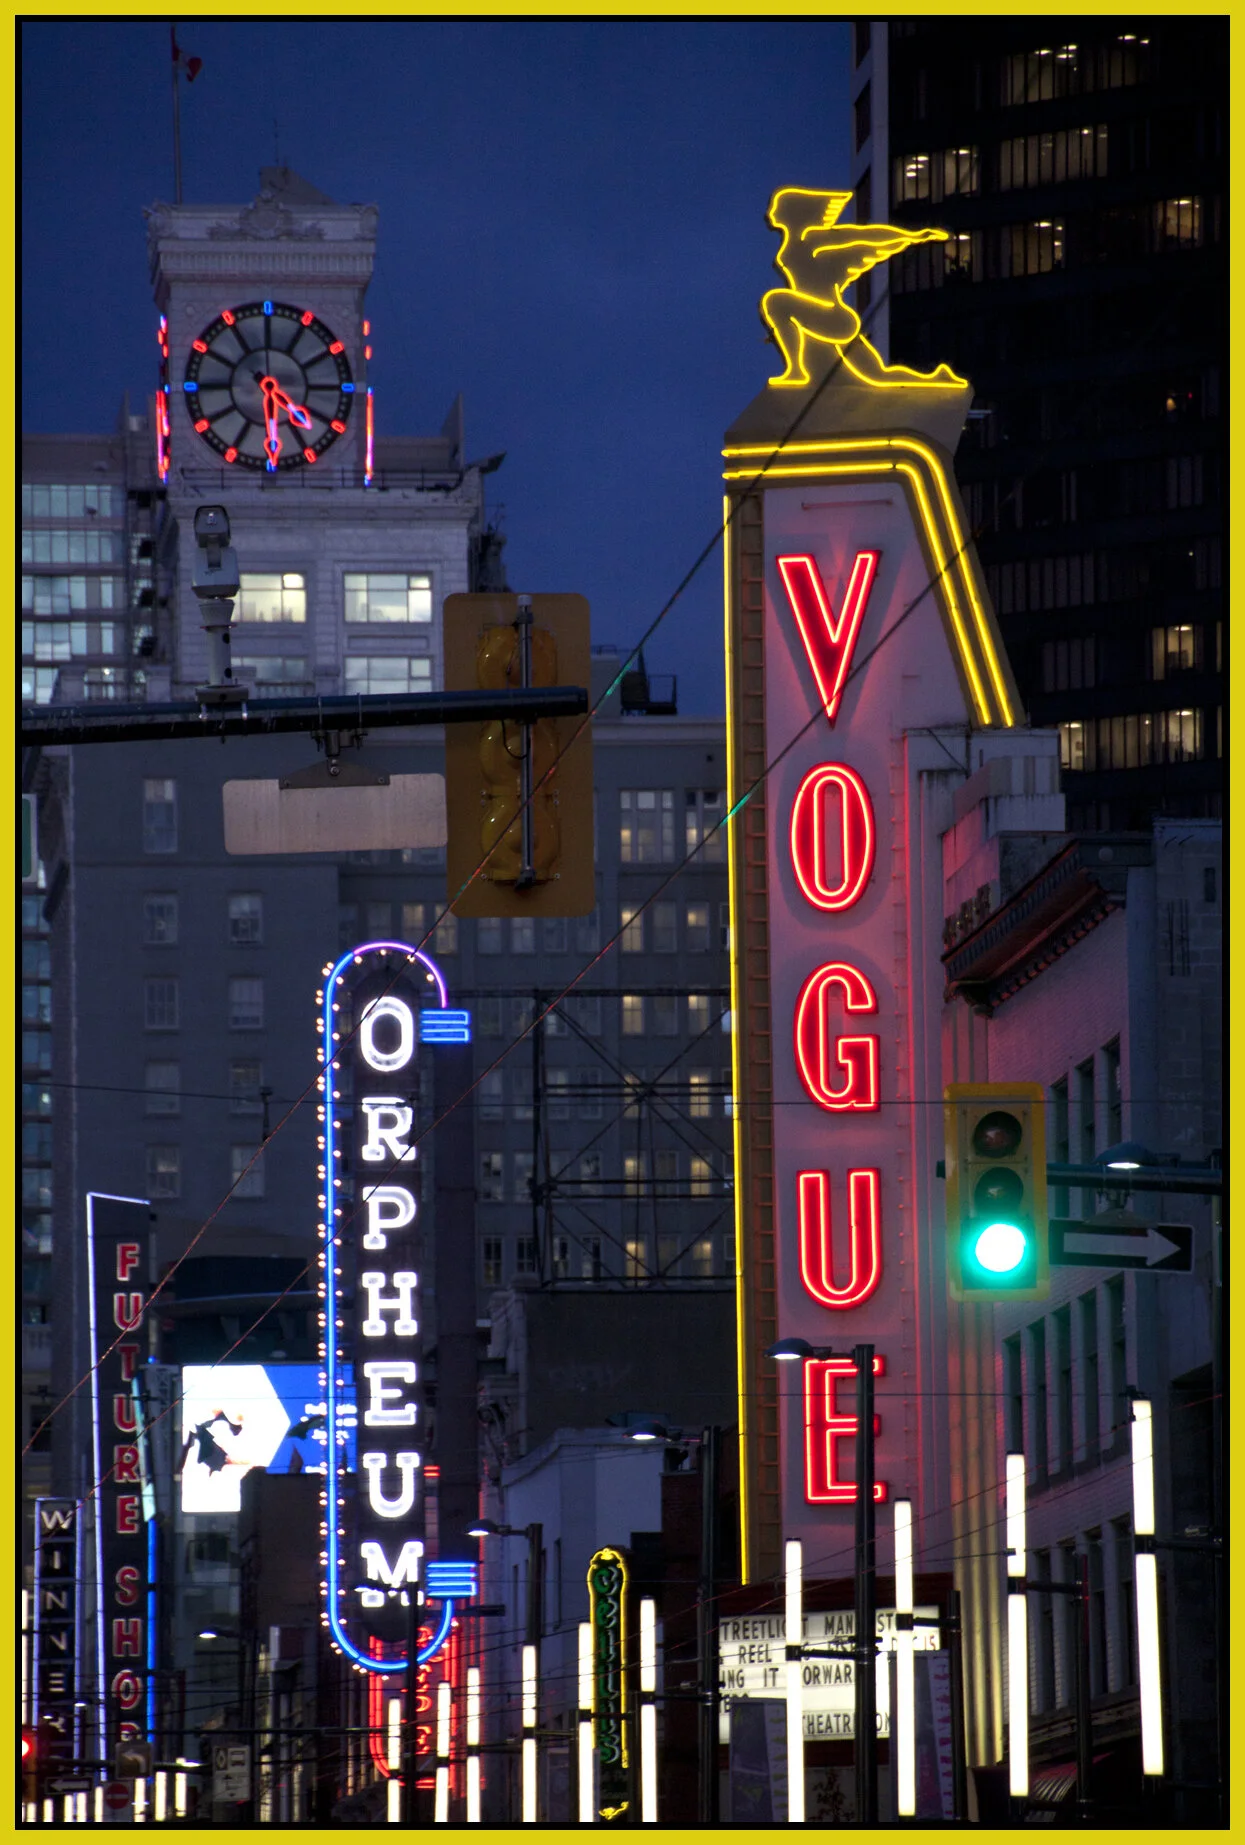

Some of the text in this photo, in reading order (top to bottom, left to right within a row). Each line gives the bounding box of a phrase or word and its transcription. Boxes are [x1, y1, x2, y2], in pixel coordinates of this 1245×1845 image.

[776, 549, 887, 1505] VOGUE
[113, 1243, 143, 1535] FUTURE
[360, 996, 424, 1608] ORPHEUM
[739, 1643, 772, 1665] REEL
[763, 1666, 780, 1688] IT
[802, 1663, 853, 1686] ORWAR
